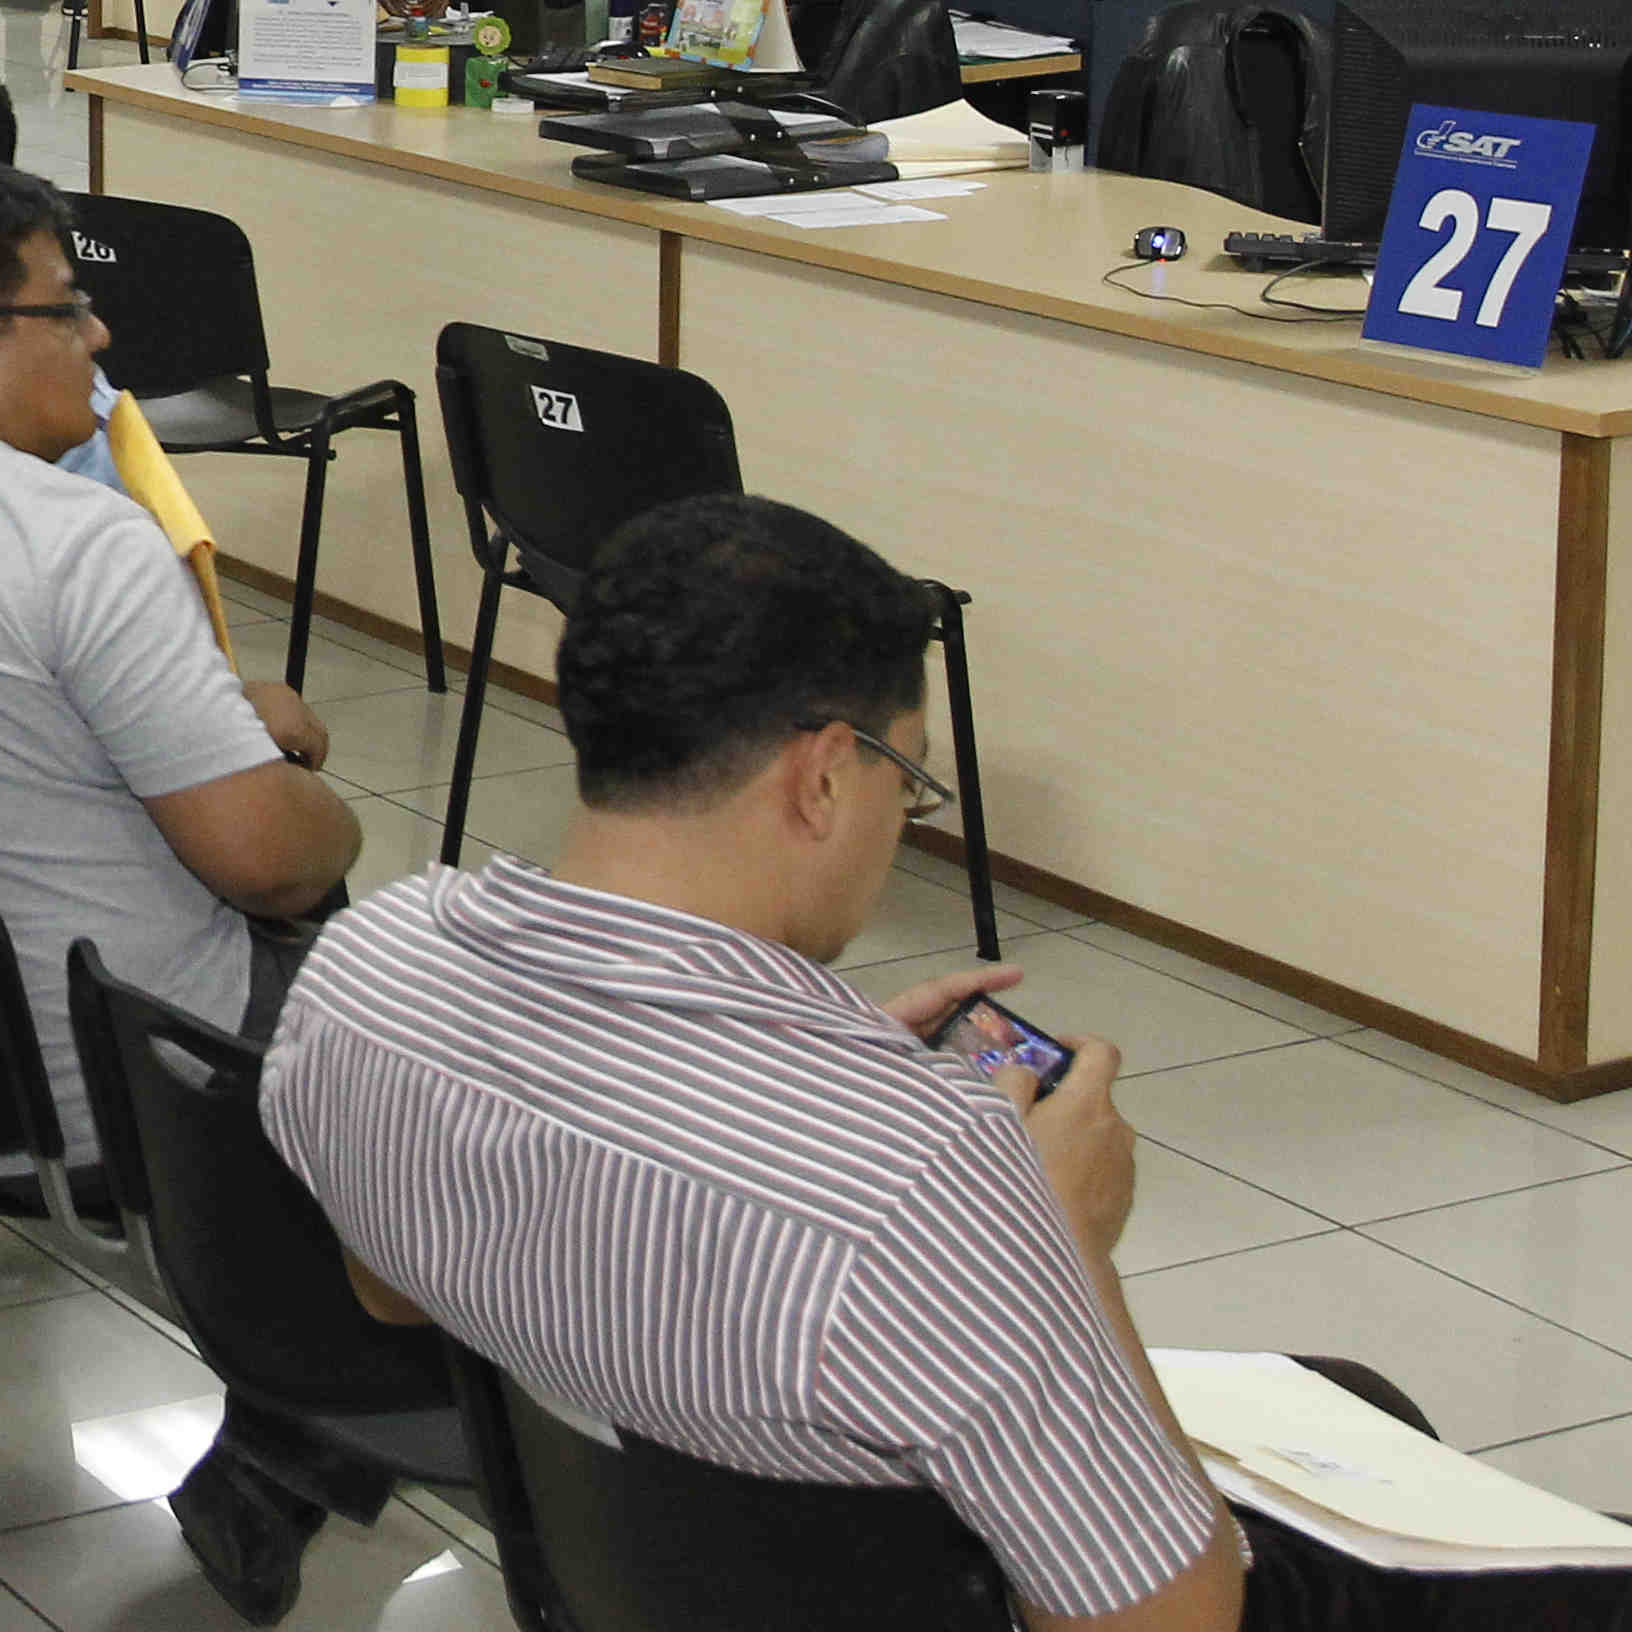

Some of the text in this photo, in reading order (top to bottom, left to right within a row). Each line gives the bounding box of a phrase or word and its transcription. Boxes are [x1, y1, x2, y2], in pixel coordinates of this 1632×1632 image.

[1443, 132, 1521, 158] SAT
[1398, 189, 1552, 328] 27
[538, 392, 574, 425] 27
